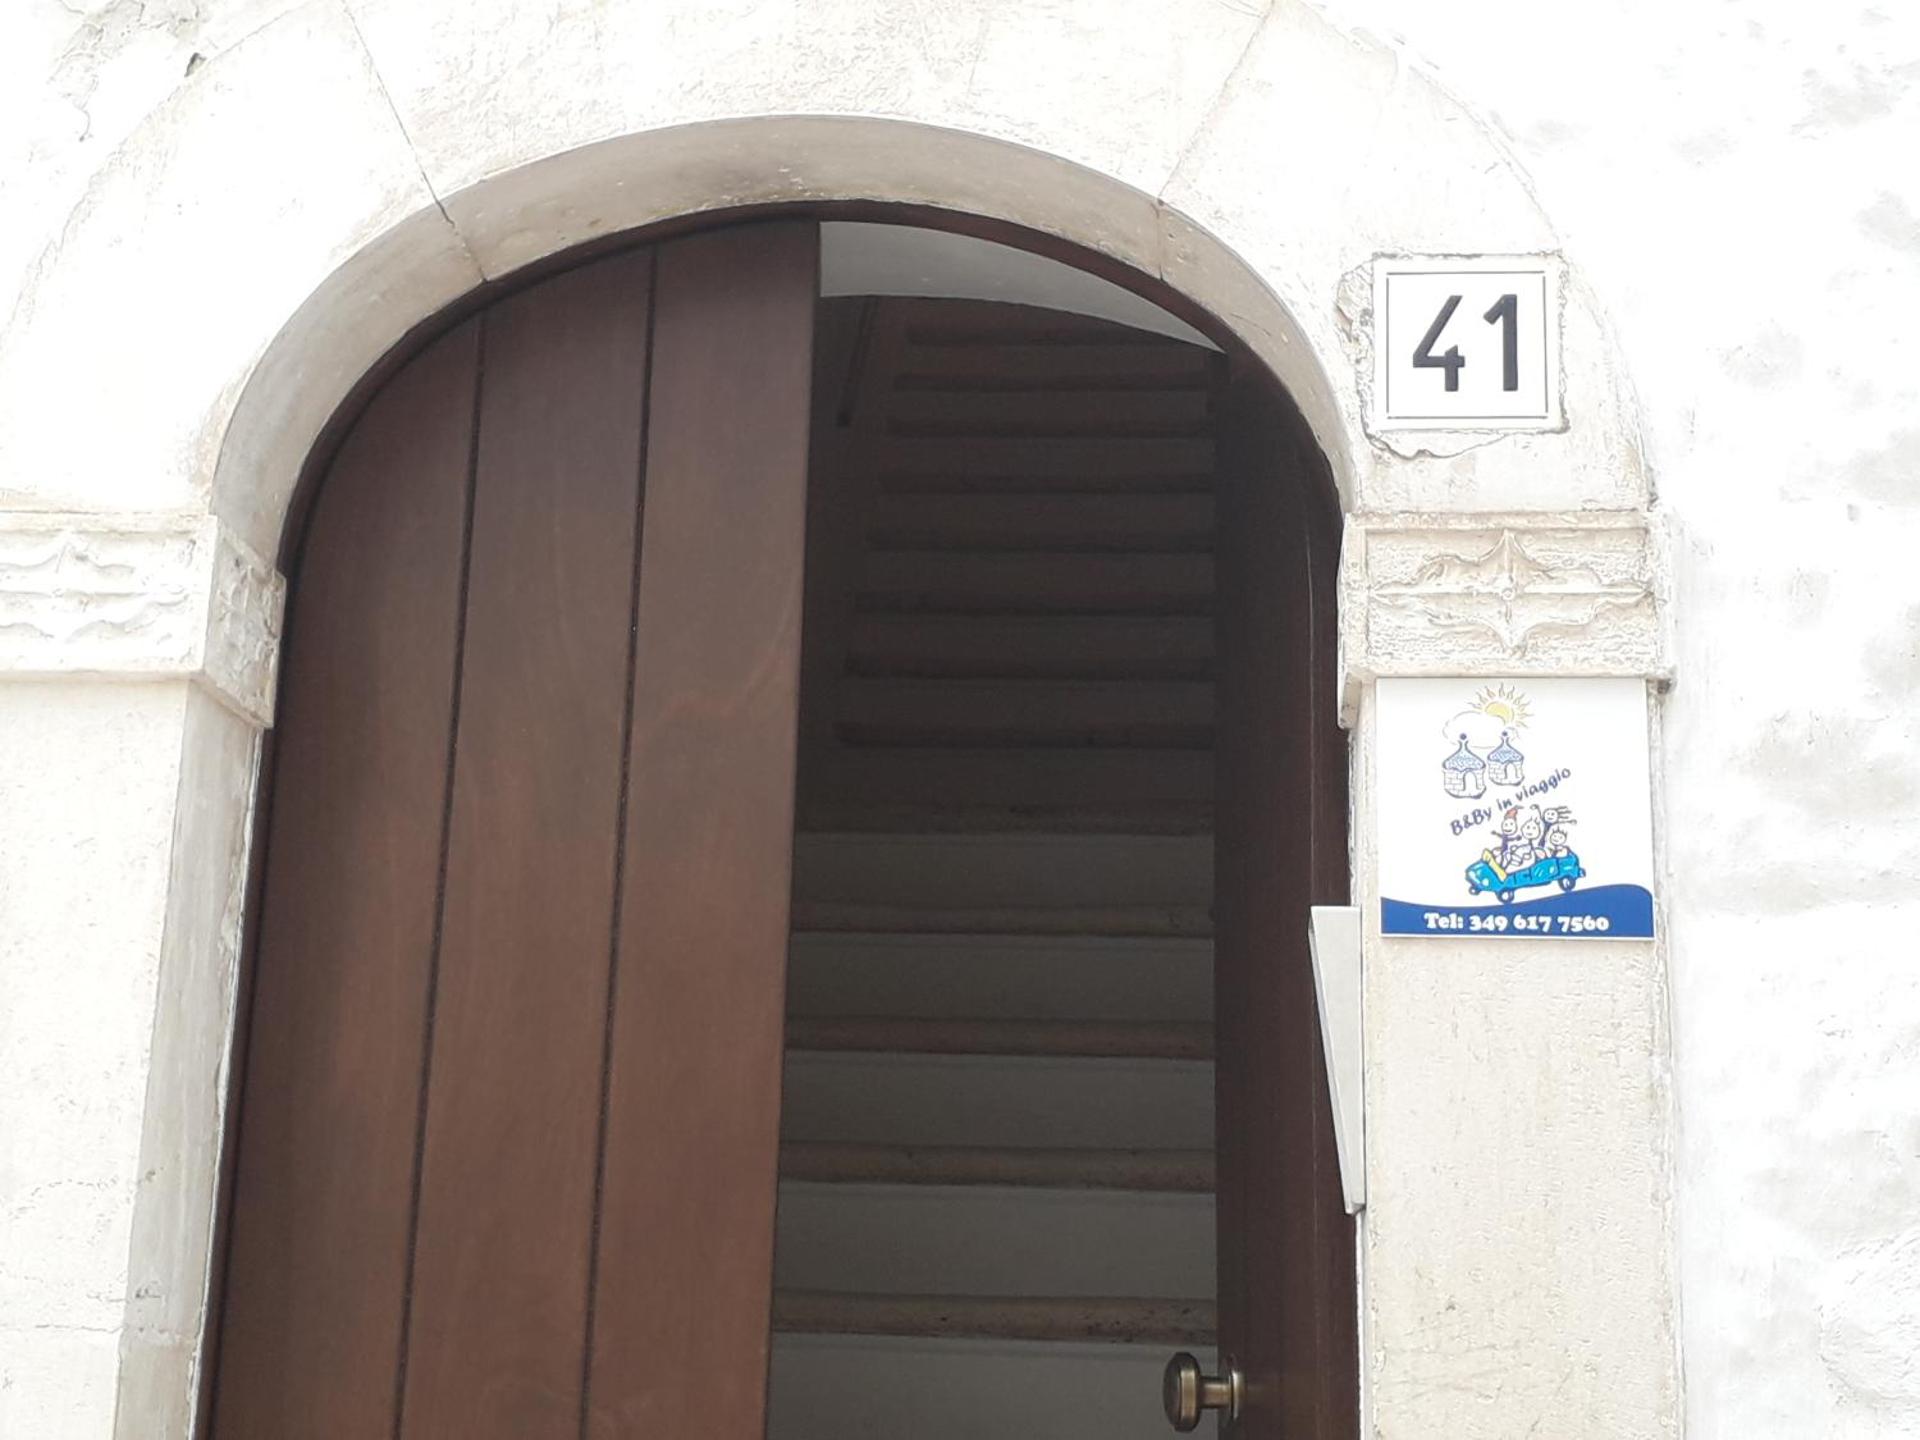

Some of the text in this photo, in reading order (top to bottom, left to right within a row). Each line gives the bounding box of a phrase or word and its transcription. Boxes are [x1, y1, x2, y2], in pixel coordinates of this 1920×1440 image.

[1413, 294, 1518, 392] 41
[1450, 768, 1571, 836] B&By in viaggio
[1424, 912, 1610, 933] Tel: 349 617 7560
